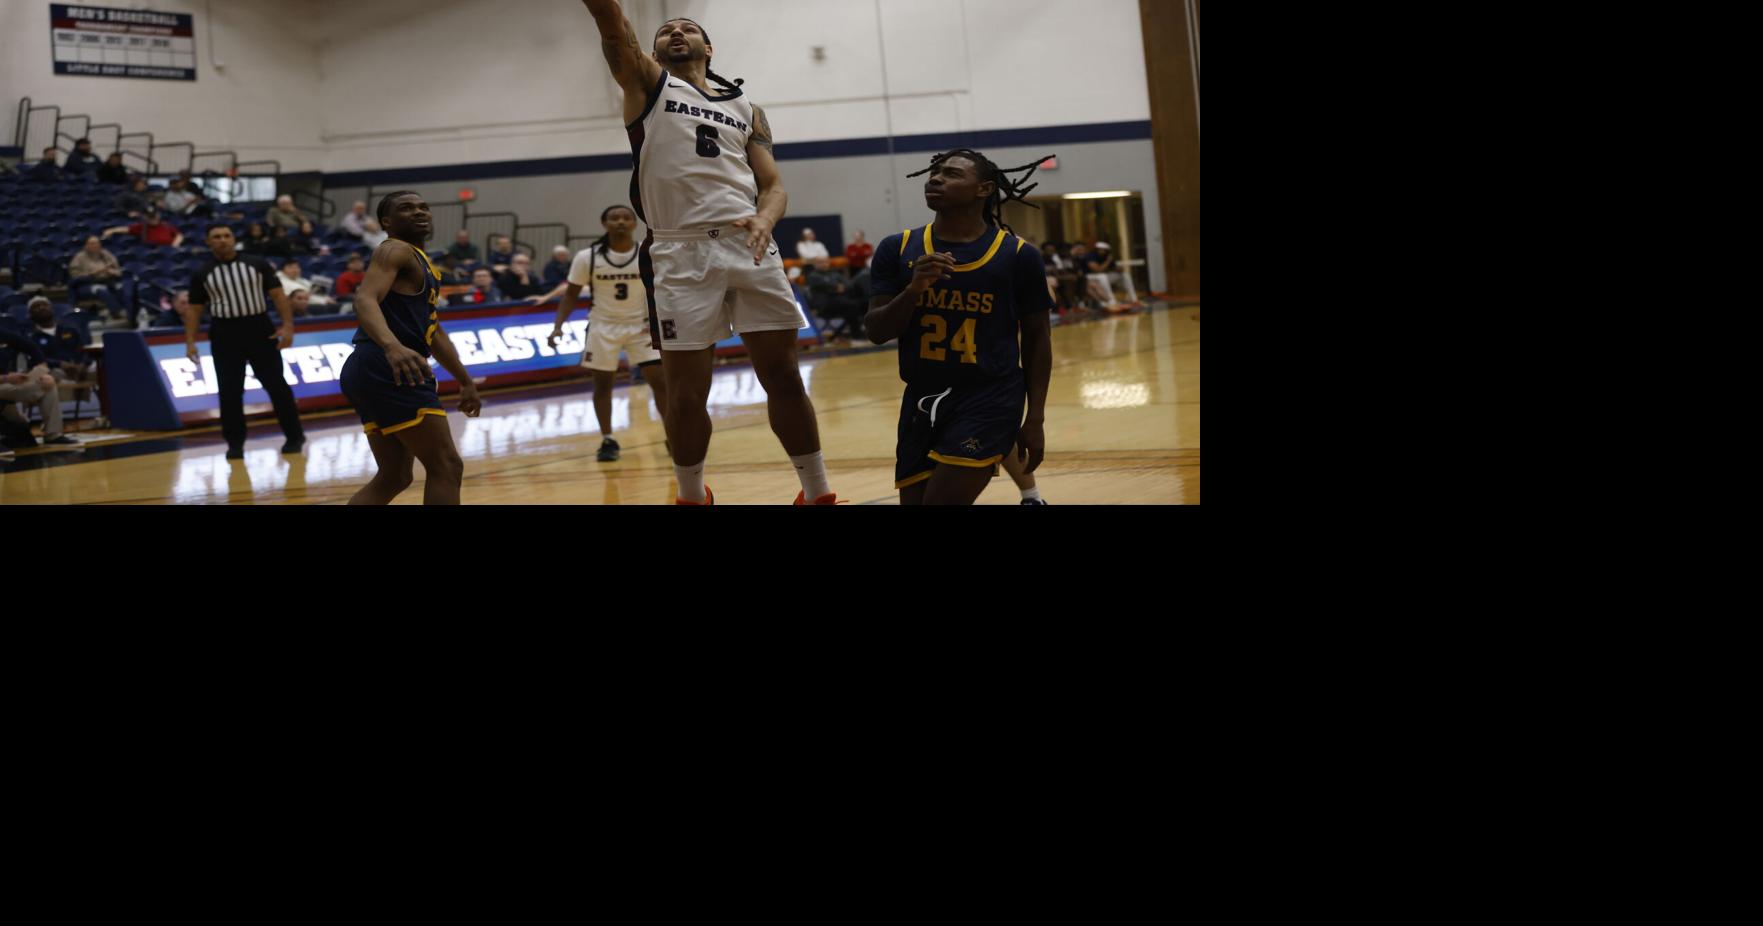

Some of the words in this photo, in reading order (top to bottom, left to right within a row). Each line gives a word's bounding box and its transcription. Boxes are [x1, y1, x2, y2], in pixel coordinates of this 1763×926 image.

[664, 100, 747, 132] EASTERN
[696, 124, 720, 158] 6
[614, 283, 628, 300] 3
[920, 313, 977, 364] 24
